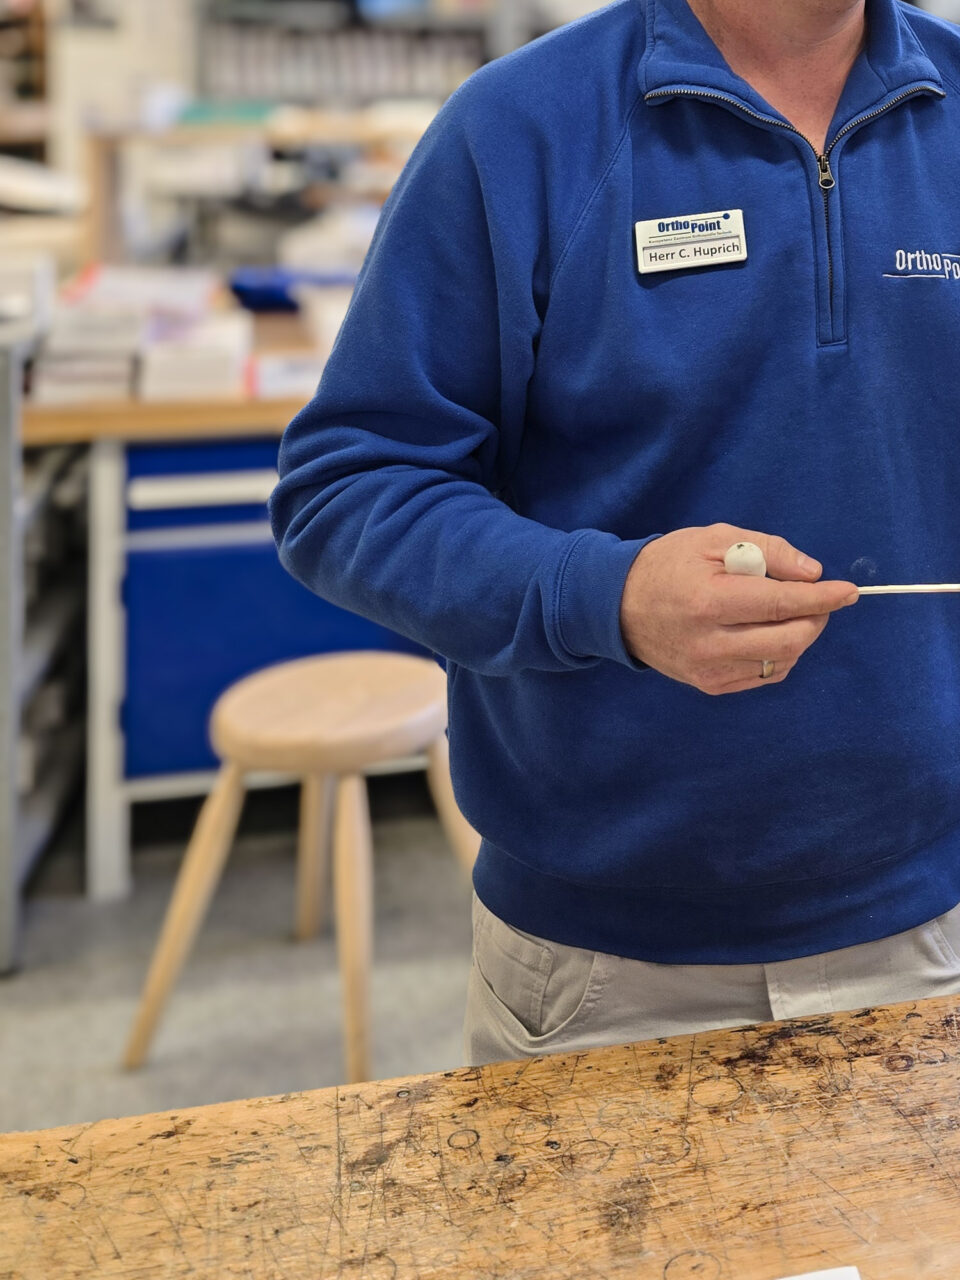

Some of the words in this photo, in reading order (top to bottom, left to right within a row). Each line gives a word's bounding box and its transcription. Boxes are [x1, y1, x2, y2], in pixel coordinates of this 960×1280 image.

[658, 220, 689, 232] Ortho
[690, 220, 721, 233] Point
[649, 252, 676, 262] Herr
[678, 248, 690, 259] C.
[693, 243, 739, 256] Huprich
[896, 250, 941, 270] Ortho
